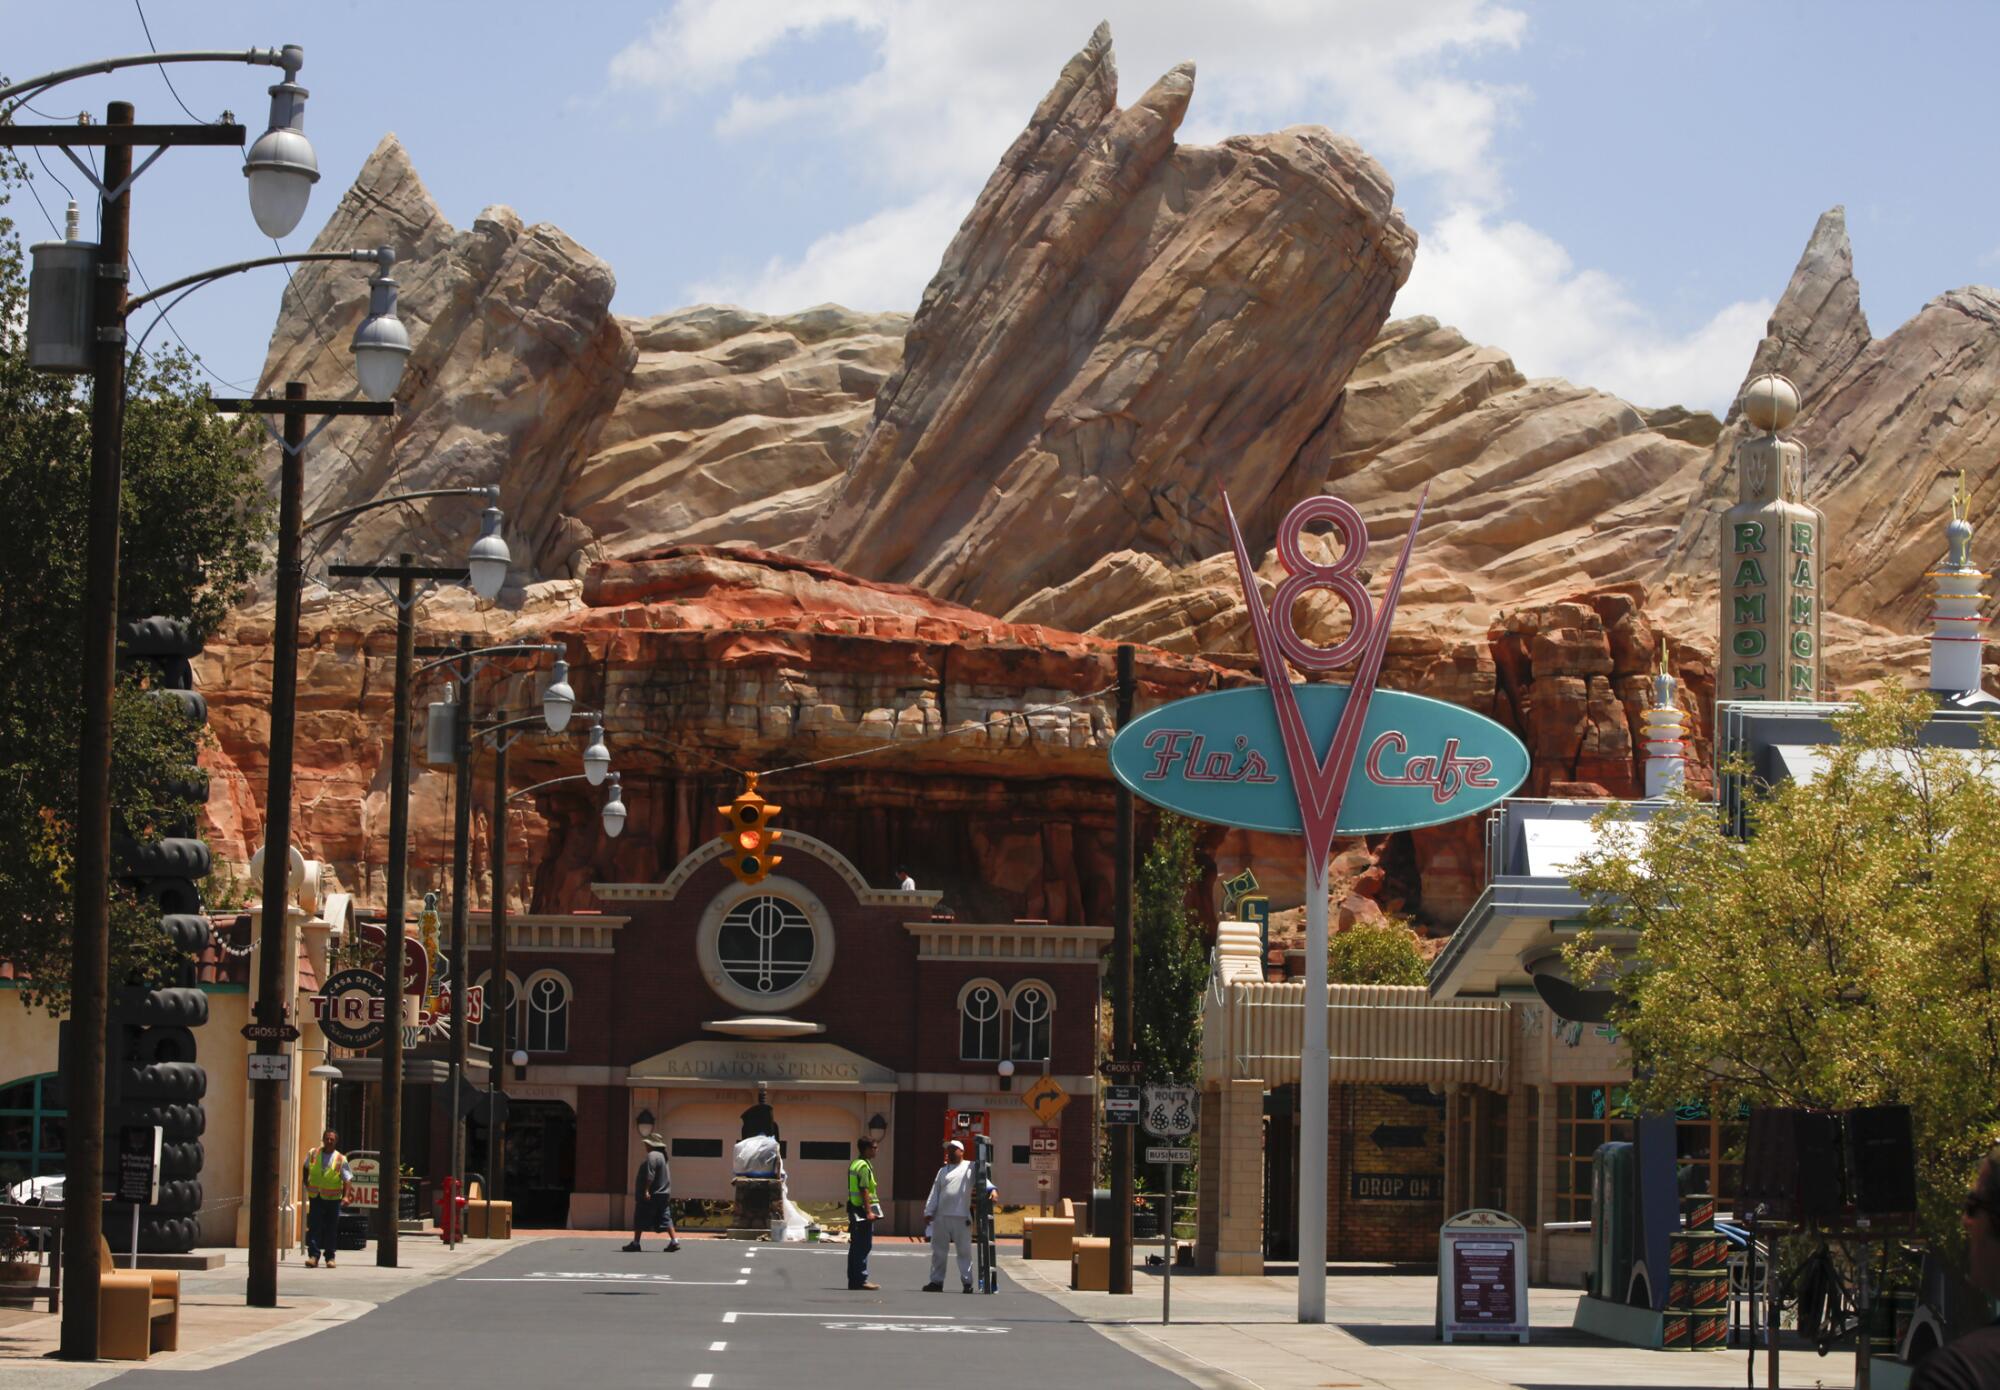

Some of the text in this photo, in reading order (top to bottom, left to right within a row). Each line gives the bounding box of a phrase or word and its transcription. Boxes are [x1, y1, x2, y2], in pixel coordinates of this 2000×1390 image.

[1733, 521, 1767, 701] RAMON
[1791, 521, 1816, 701] RAMON
[1142, 728, 1278, 785] Flo's
[1365, 730, 1500, 806] Cafe
[329, 976, 352, 994] CASA
[248, 1027, 278, 1037] CROSS
[668, 1060, 860, 1076] RADIATOR SPRINGS
[1106, 1064, 1131, 1072] CROSS
[1155, 1091, 1186, 1100] ROUTE
[1151, 1103, 1190, 1130] 66
[1150, 1151, 1189, 1159] BUSINESS
[348, 1187, 378, 1205] SALE
[1360, 1178, 1403, 1196] DROP
[1410, 1179, 1430, 1197] ON
